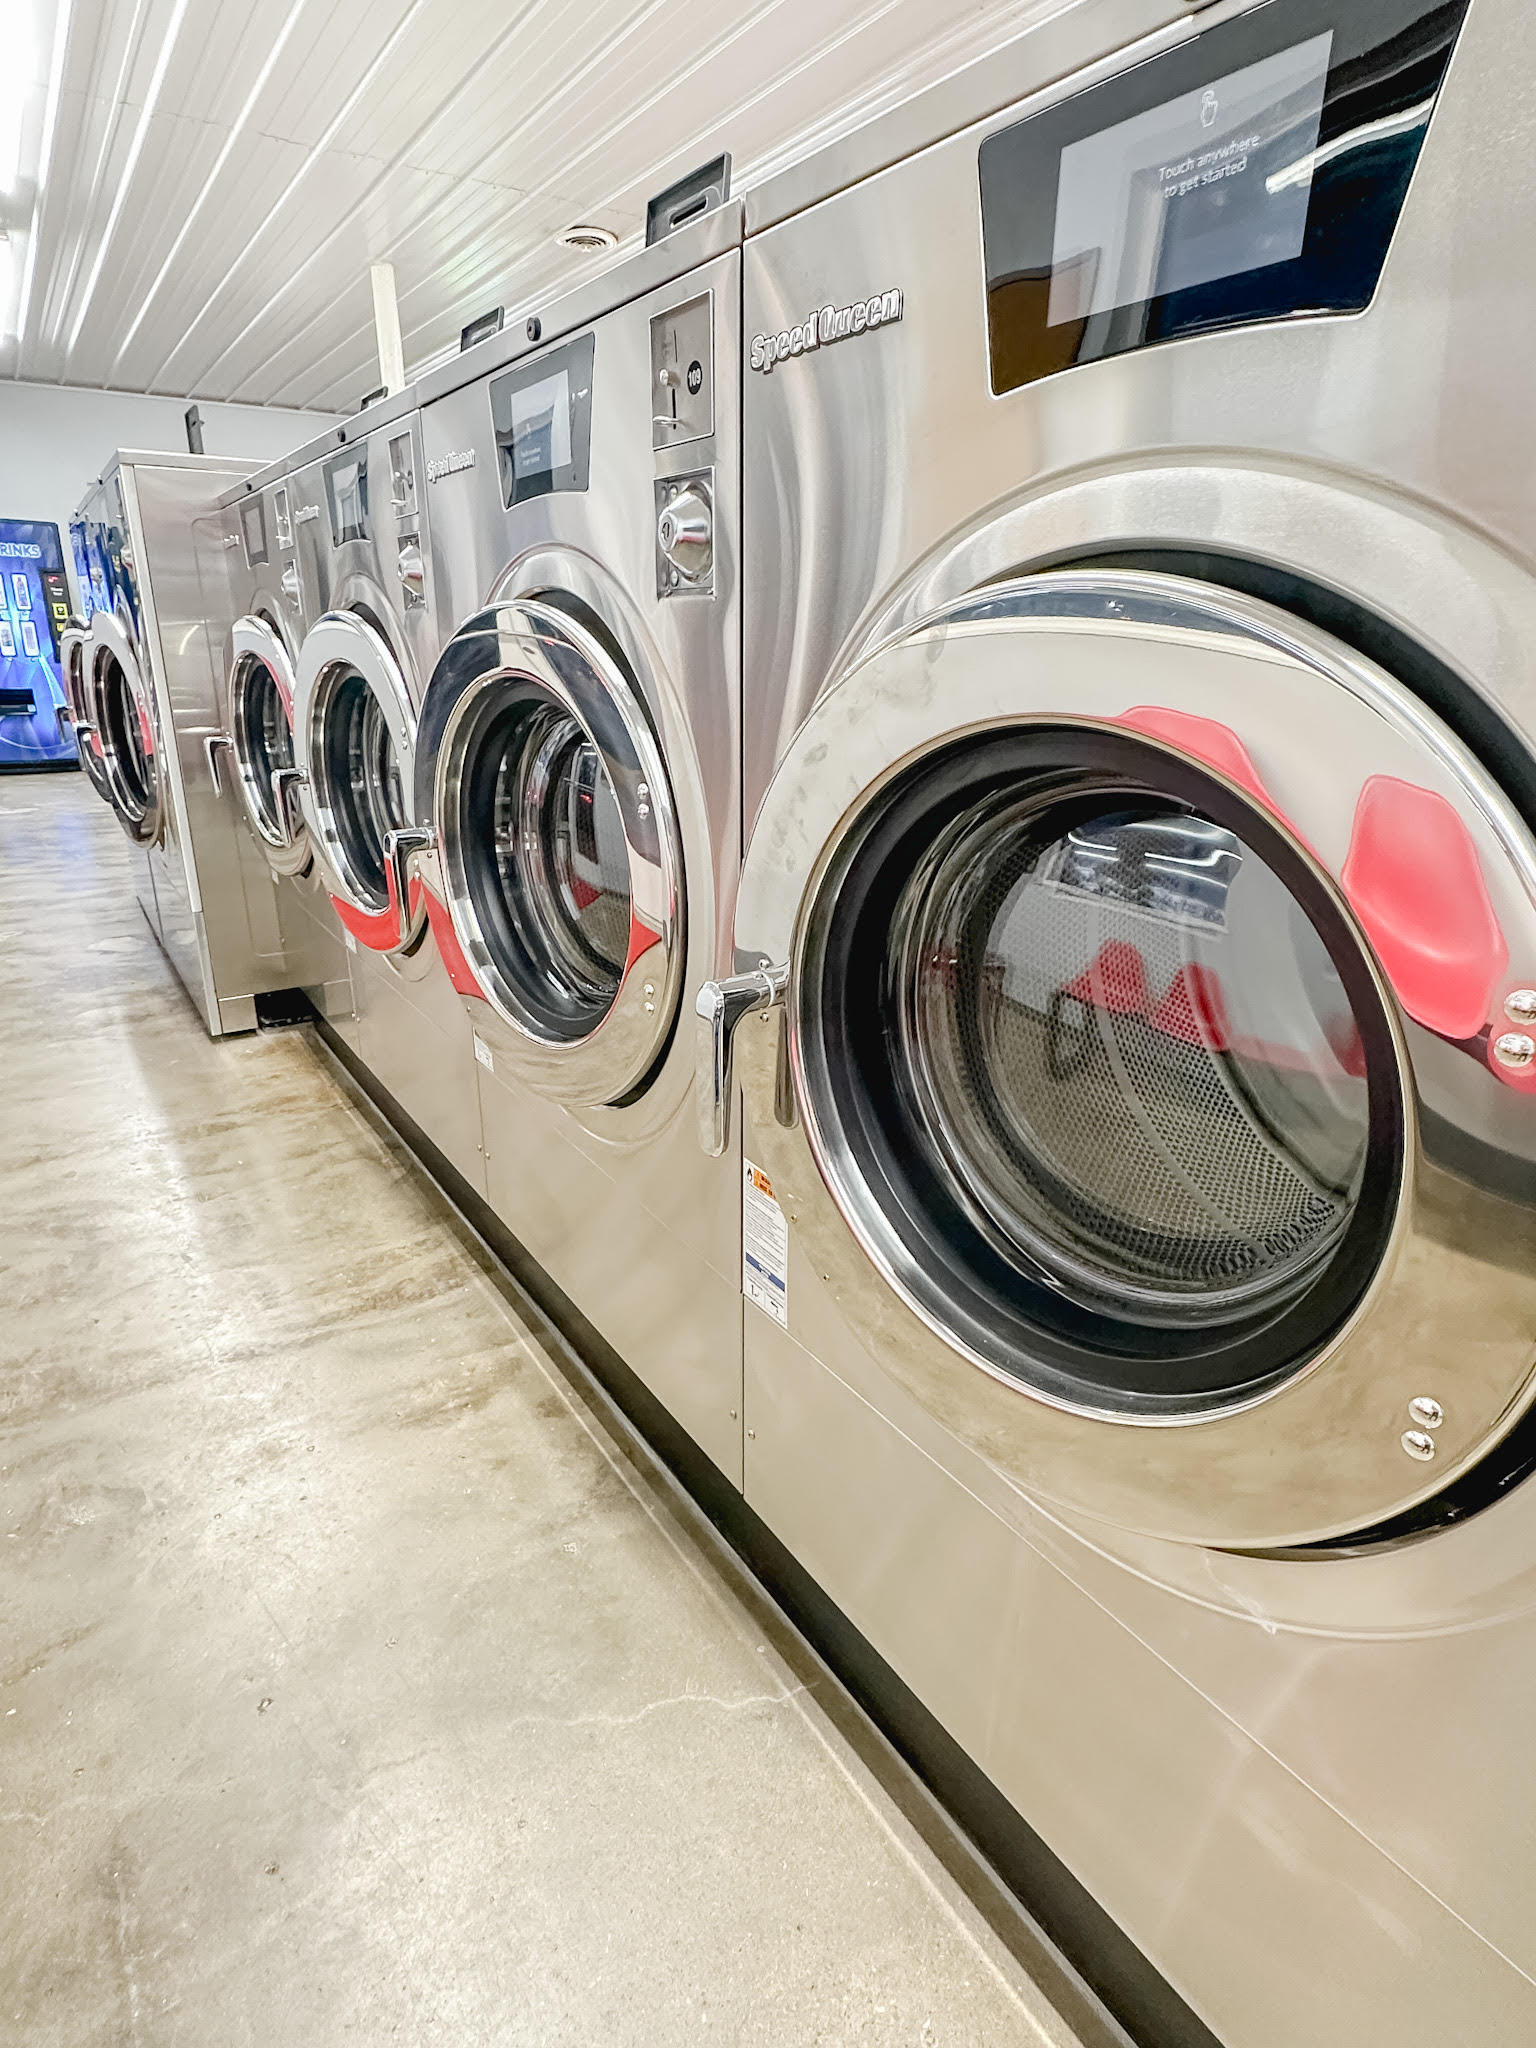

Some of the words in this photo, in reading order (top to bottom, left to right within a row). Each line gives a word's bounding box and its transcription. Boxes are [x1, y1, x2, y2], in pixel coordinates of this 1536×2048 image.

[1159, 158, 1195, 182] Touch
[1197, 135, 1261, 165] anywhere
[1164, 185, 1178, 199] to
[1178, 174, 1200, 196] get
[1200, 155, 1248, 185] started
[750, 311, 820, 374] Speed
[817, 288, 904, 346] Queen
[688, 367, 701, 388] 109
